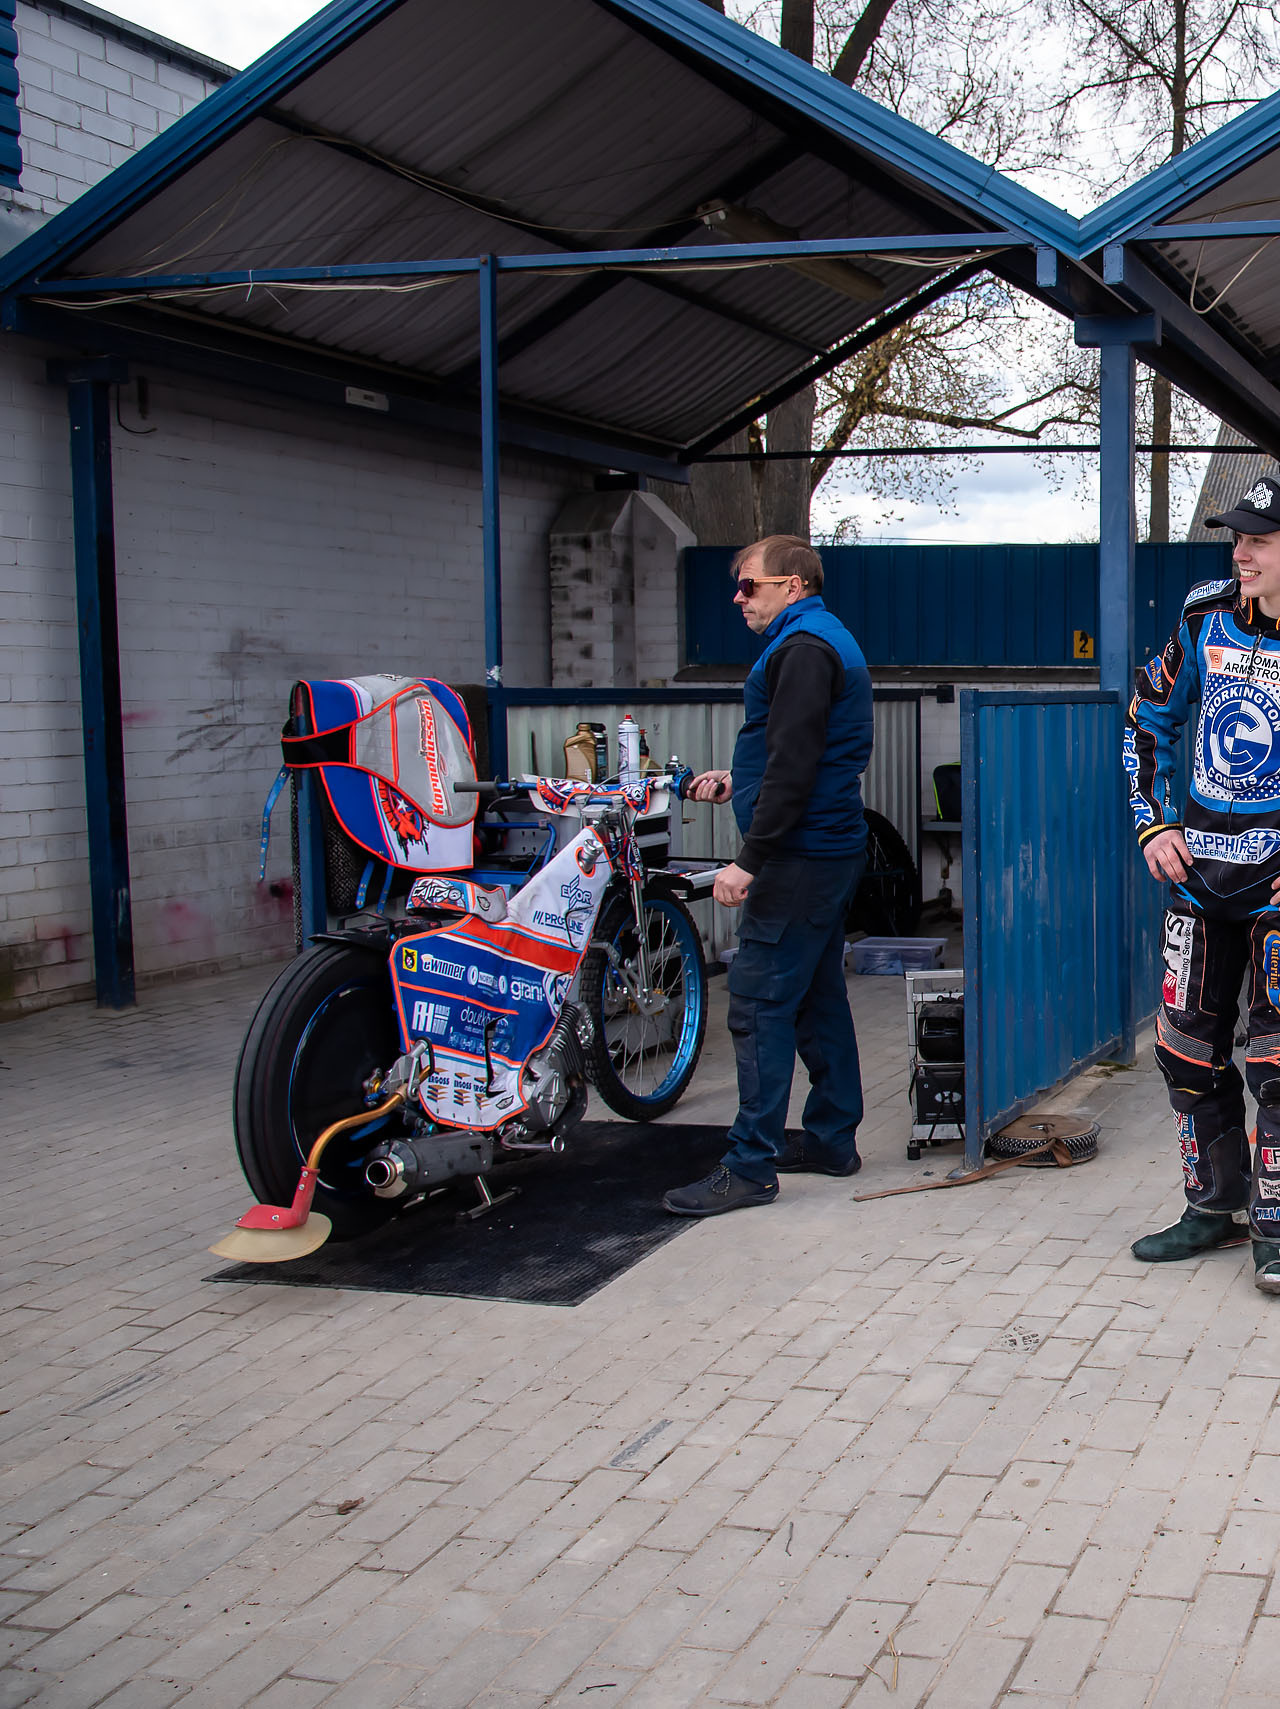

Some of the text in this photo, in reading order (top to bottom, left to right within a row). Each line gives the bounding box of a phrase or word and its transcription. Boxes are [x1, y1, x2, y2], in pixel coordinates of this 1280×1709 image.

[1079, 631, 1089, 653] 2
[1207, 766, 1258, 790] COMETS
[1186, 830, 1258, 855] SAPPHIRE
[1178, 957, 1191, 990] Training
